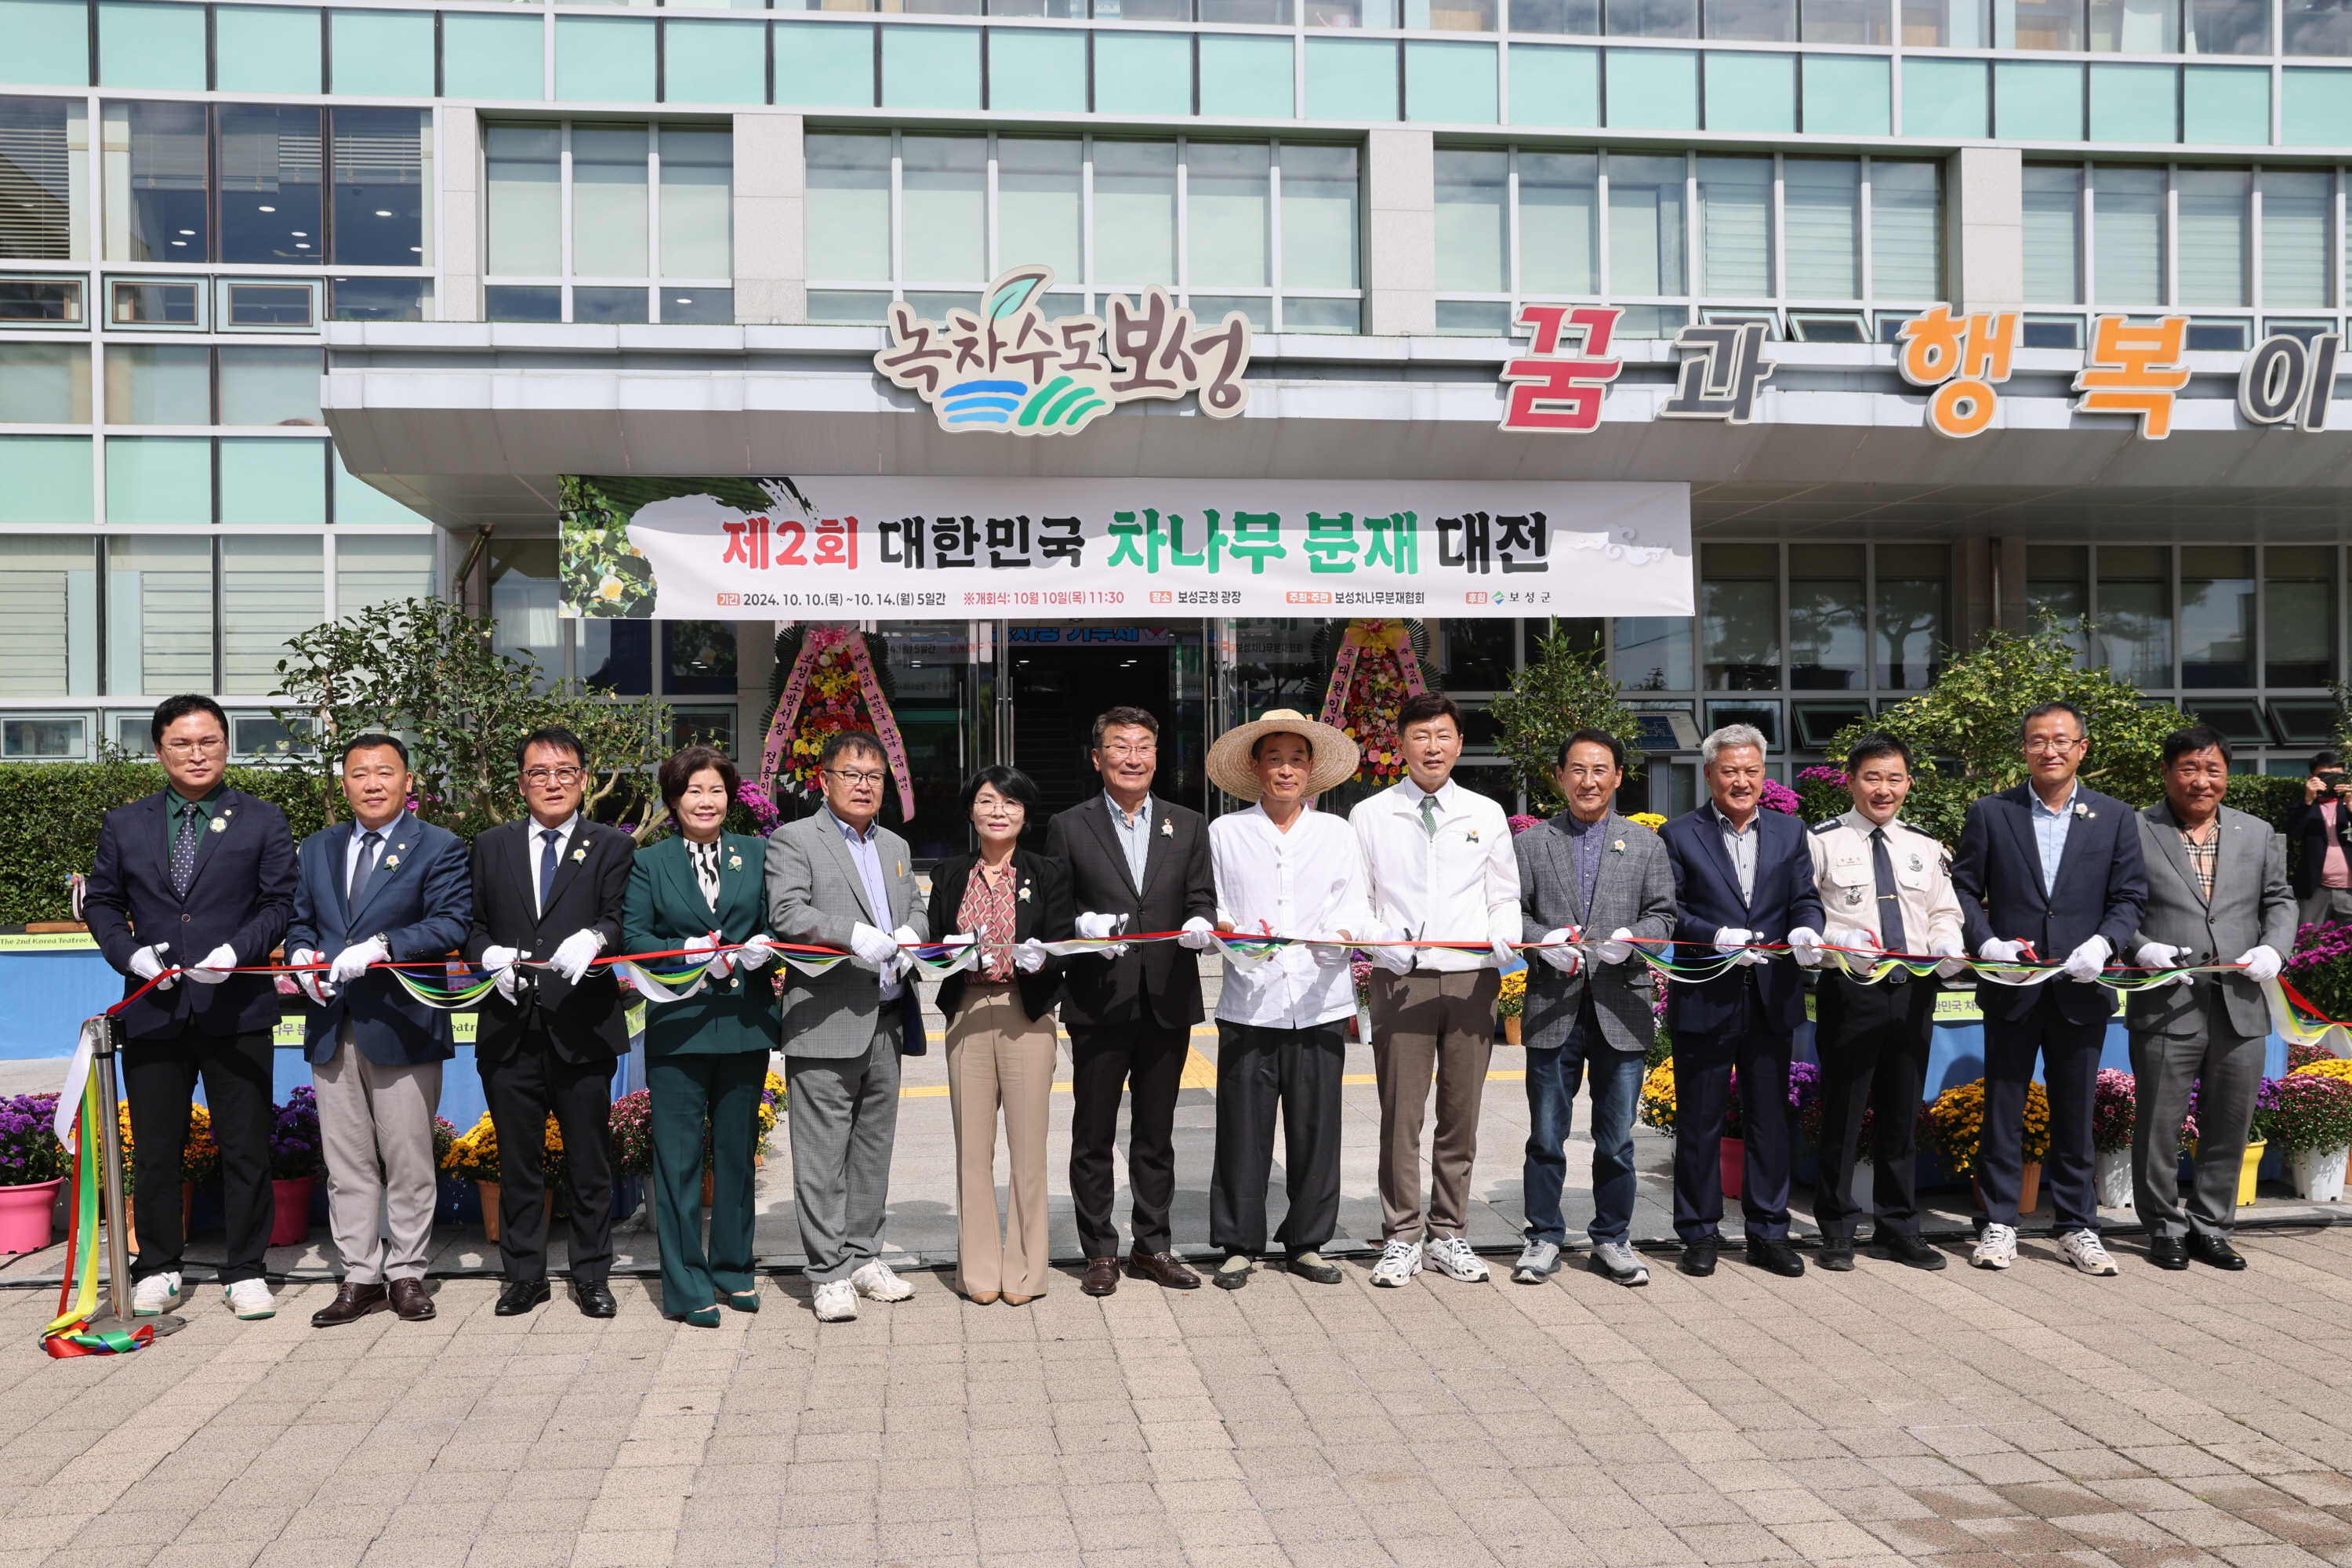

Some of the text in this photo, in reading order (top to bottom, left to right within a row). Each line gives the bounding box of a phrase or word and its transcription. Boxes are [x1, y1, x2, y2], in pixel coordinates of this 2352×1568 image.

[1109, 292, 1244, 408] 보성
[723, 508, 1549, 575] 제2회 대한민국 차나무 분재 대전
[719, 593, 740, 605] 기간
[743, 593, 779, 606] 2024.
[783, 593, 802, 606] 10.
[917, 592, 946, 605] 5일간
[1014, 591, 1040, 605] 10월
[1043, 590, 1086, 605] 10일(목)
[1090, 591, 1124, 604] 11:30
[1152, 590, 1242, 604] 장소 보성군청 광장
[1335, 591, 1425, 604] 보성차나무분재협회
[1467, 592, 1486, 604] 후원
